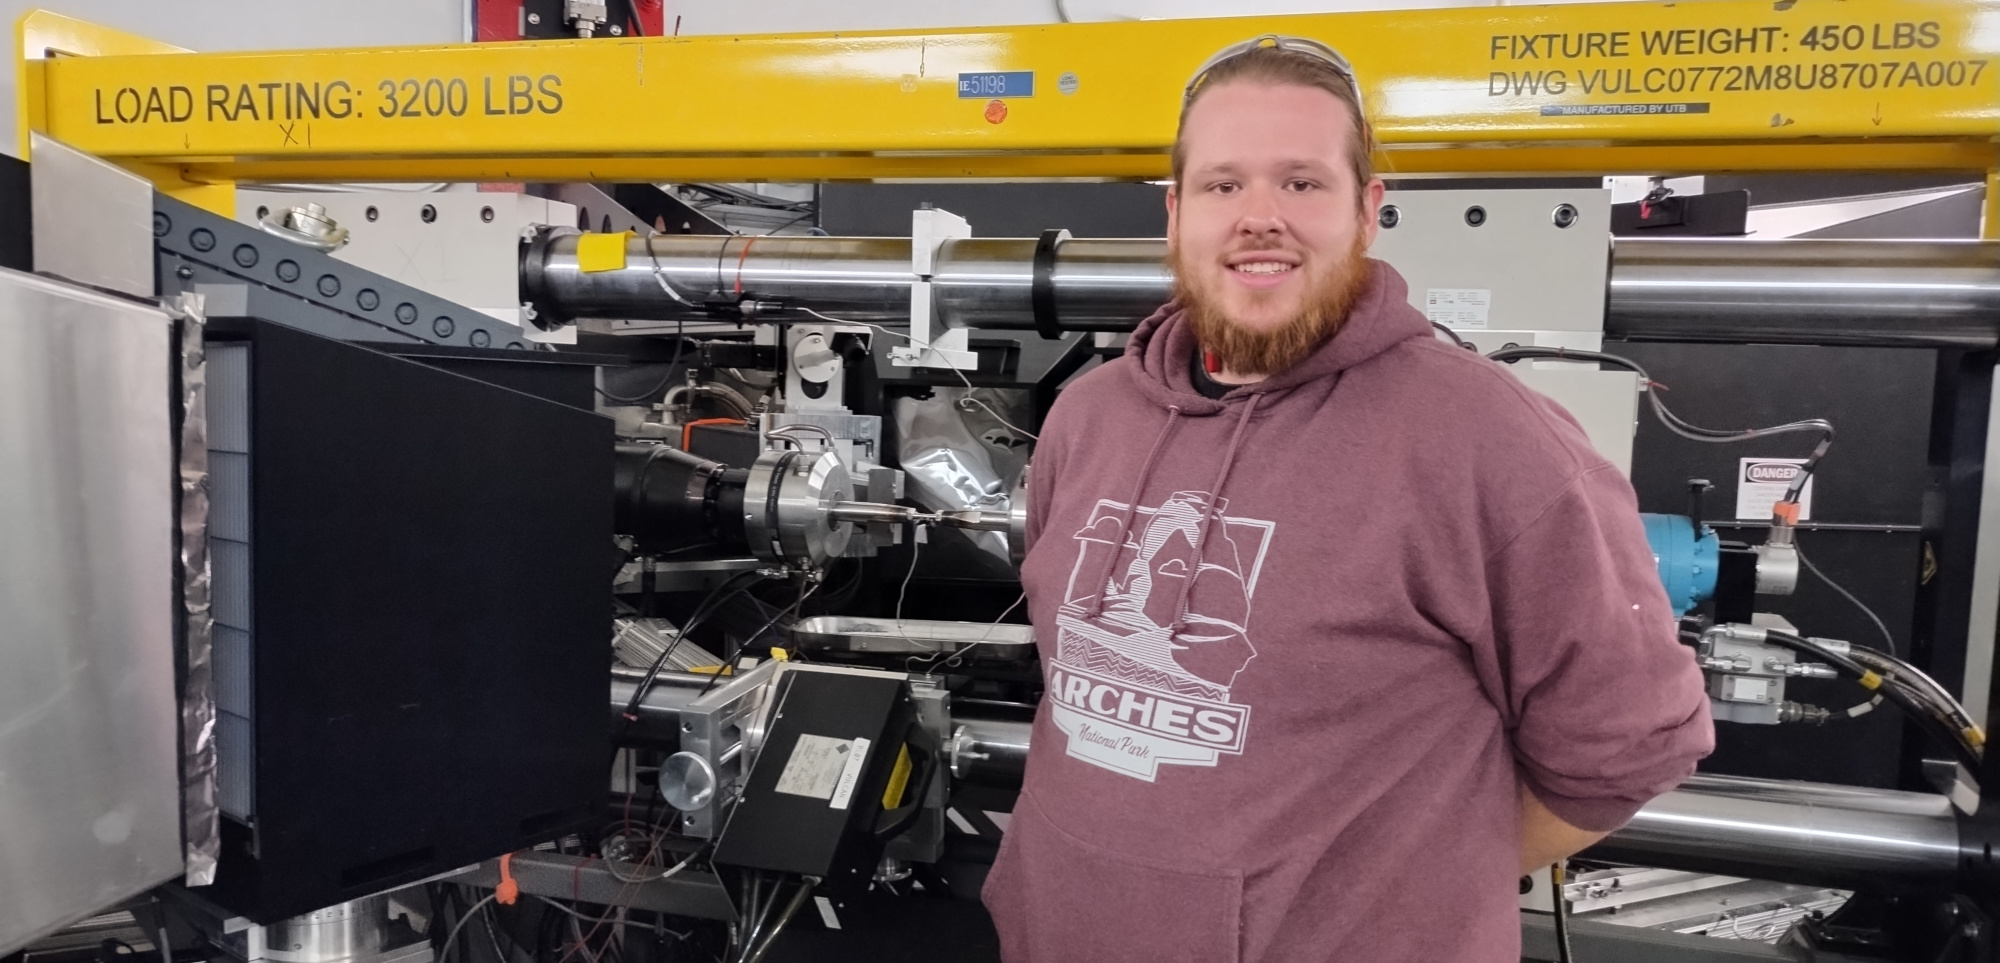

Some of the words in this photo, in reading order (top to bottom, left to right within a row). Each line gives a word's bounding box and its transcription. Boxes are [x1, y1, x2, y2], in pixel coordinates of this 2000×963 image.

[1490, 31, 1630, 60] FIXTURE
[1641, 26, 1789, 56] WEIGHT:
[1799, 24, 1865, 51] 450
[1872, 21, 1941, 50] LBS
[1488, 70, 1567, 97] DWG
[1577, 59, 1988, 95] VULC0772M8U8707A007
[95, 85, 194, 124] LOAD
[206, 80, 363, 122] RATING:
[378, 77, 468, 118] 3200
[484, 74, 563, 116] LBS
[1562, 104, 1647, 115] MANUFACTURED
[1649, 104, 1664, 113] BY
[1665, 103, 1687, 113] UTB
[1752, 467, 1799, 479] DANGER
[1051, 670, 1237, 743] ARCHES
[1078, 722, 1120, 751] National
[1120, 735, 1150, 759] Park
